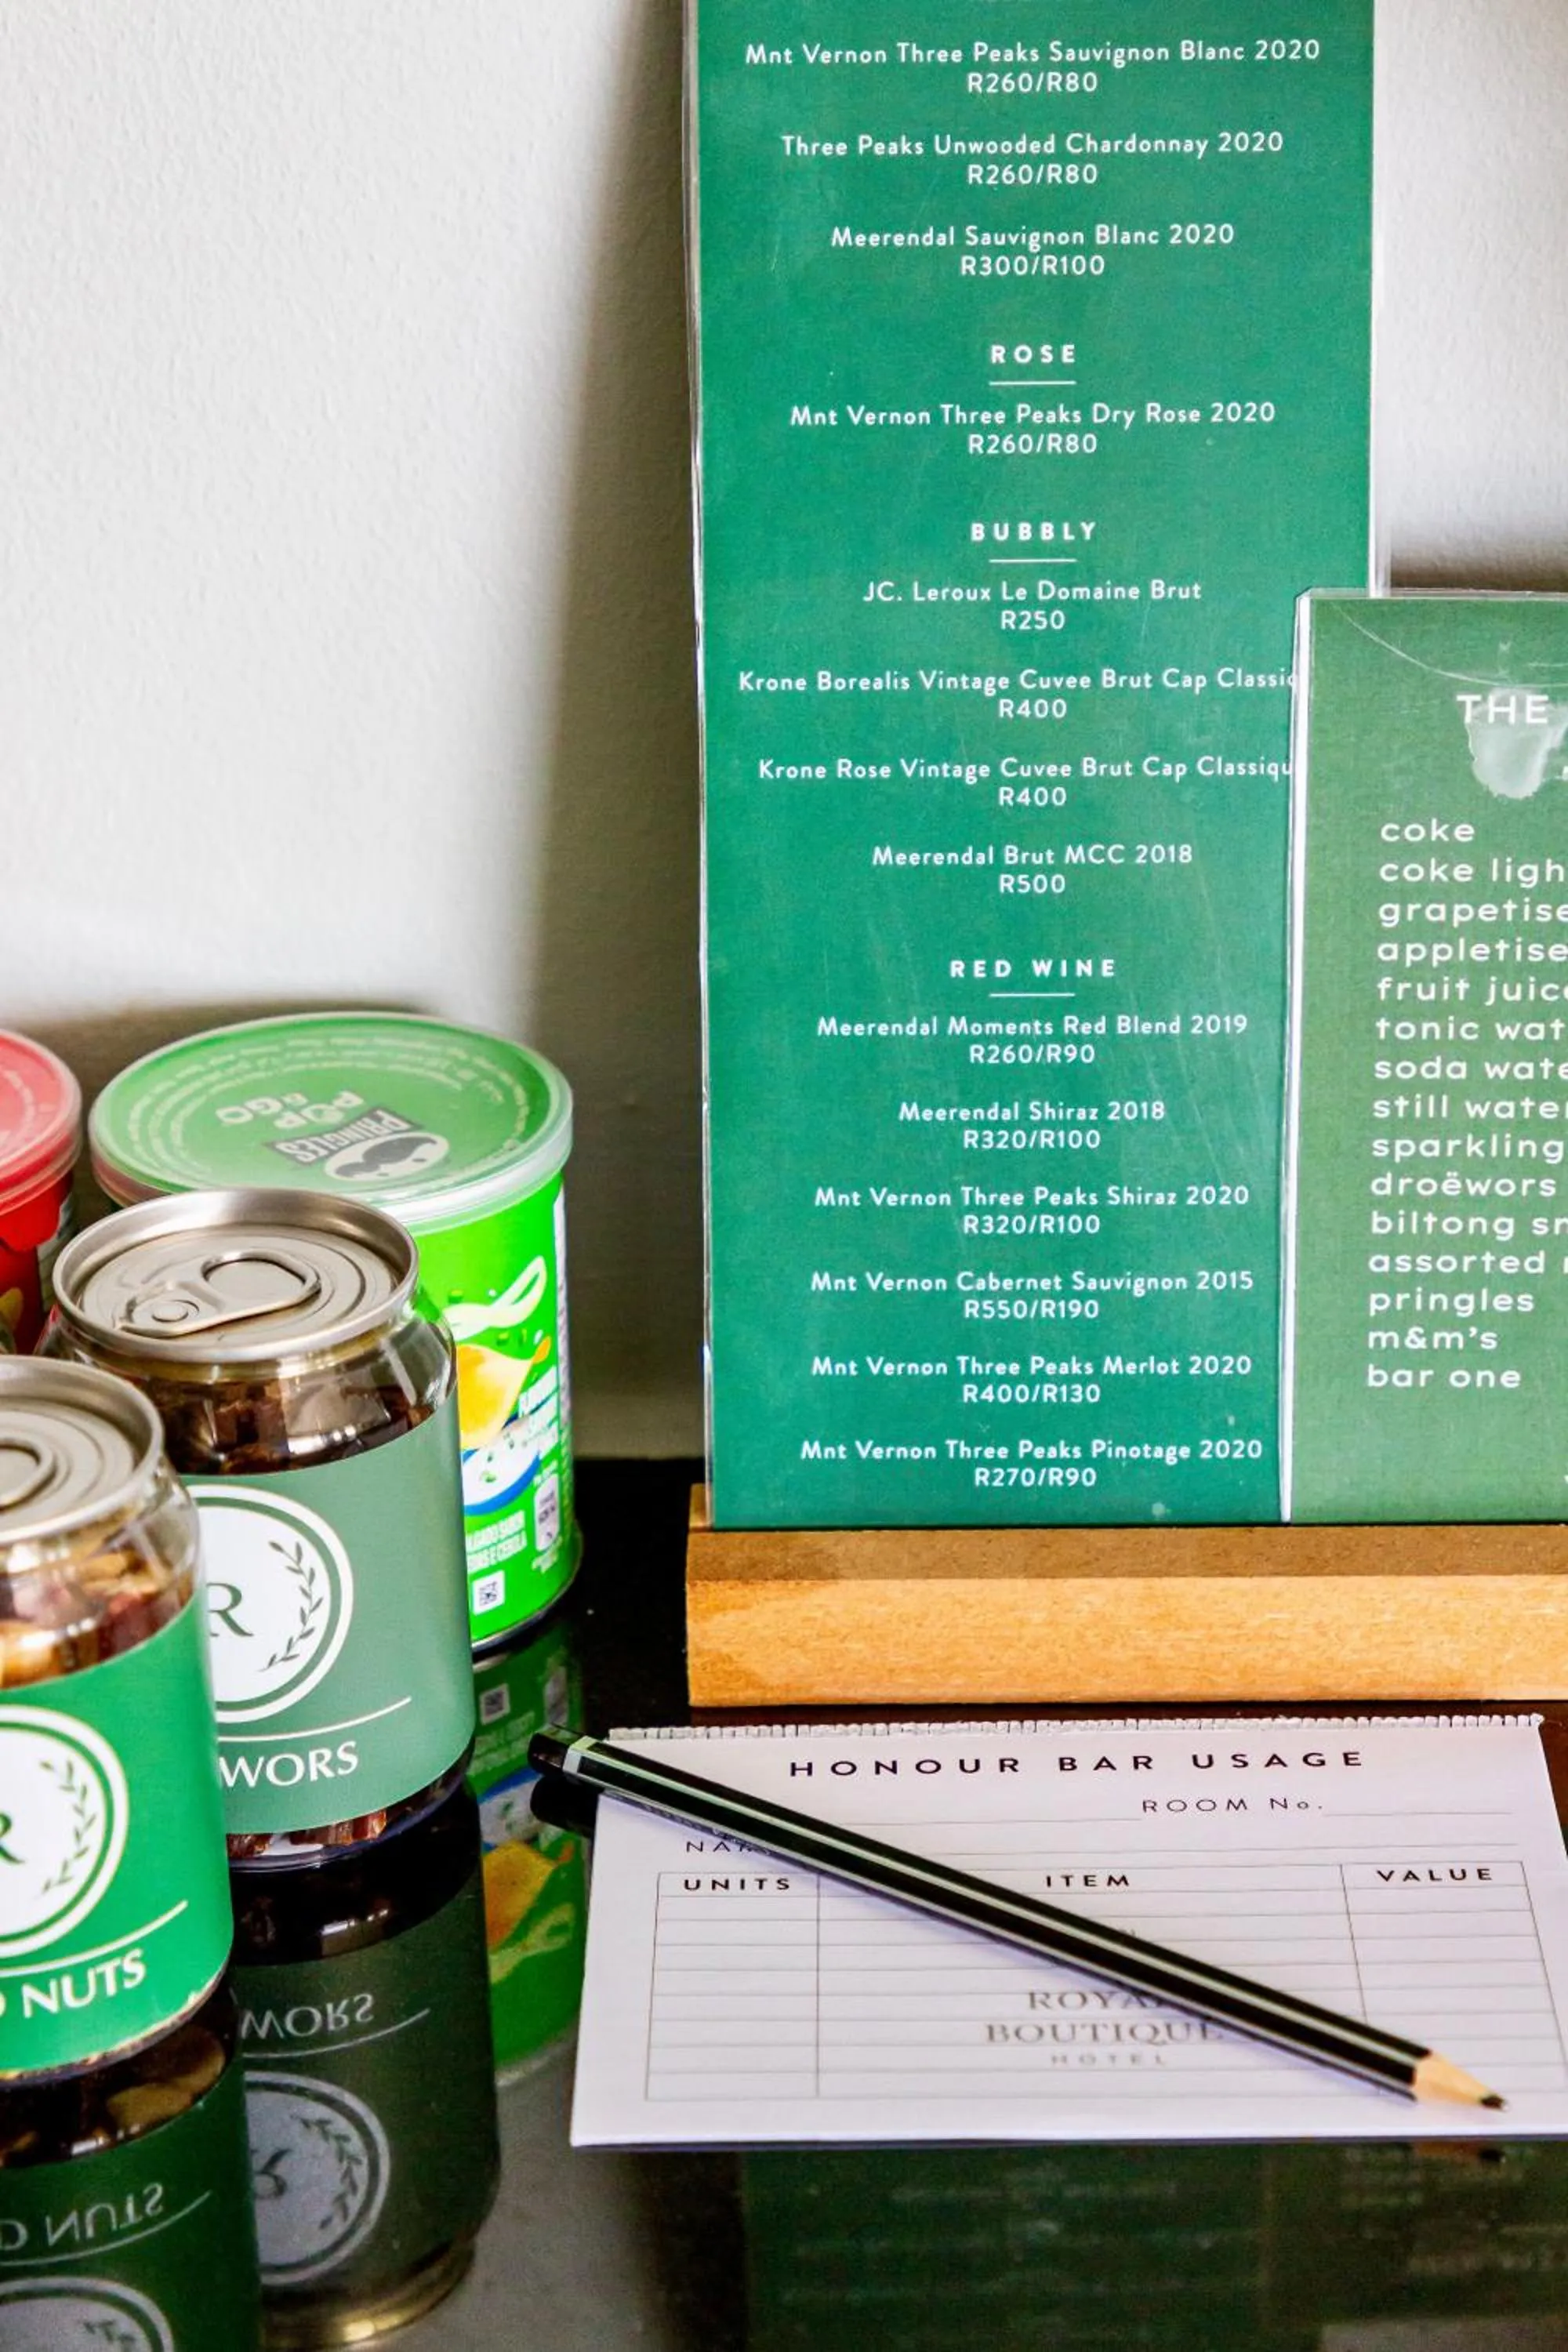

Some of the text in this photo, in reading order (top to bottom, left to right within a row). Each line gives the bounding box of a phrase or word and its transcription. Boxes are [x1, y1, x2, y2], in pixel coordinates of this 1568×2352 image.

[746, 38, 1319, 69] Mnt Vernon Three Peaks Sauvignon Blanc 2020
[967, 71, 1098, 94] R260/R80
[782, 131, 1283, 160] Three Peaks Unwooded Chardonnay 2020
[967, 163, 1098, 185] R260/R80
[831, 223, 1235, 254] Meerendal Sauvignon Blanc 2020
[960, 254, 1105, 277] R300/R100
[990, 344, 1075, 364] ROSE
[790, 401, 1276, 430] Mnt Vernon Three Peaks Dry Rose 2020
[968, 432, 1097, 454] R260/R80
[971, 521, 1095, 542] BUBBLY
[863, 579, 1202, 602] JC. Leroux Le Domaine Brut
[1000, 609, 1065, 630] R250
[739, 671, 807, 691] Krone
[817, 670, 910, 691] Borealis
[919, 670, 1010, 697] Vintage
[1019, 668, 1091, 690] Cuvee
[1101, 668, 1152, 689] Brut
[1162, 667, 1207, 695] Cap
[999, 698, 1067, 719] R400
[1456, 694, 1549, 724] THE
[759, 759, 826, 779] Krone
[837, 758, 891, 779] Rose
[900, 758, 990, 785] Vintage
[1000, 757, 1072, 778] Cuvee
[1080, 756, 1133, 777] Brut
[1142, 755, 1188, 783] Cap
[998, 786, 1067, 807] R400
[1381, 818, 1475, 843] coke
[873, 843, 1193, 866] Meerendal Brut MCC 2018
[1379, 857, 1474, 883] coke
[999, 873, 1065, 894] R500
[949, 958, 1115, 978] RED WINE
[1377, 976, 1568, 1006] fruit juic
[818, 1013, 1249, 1036] Meerendal Moments Red Blend 2019
[1375, 1015, 1479, 1040] tonic
[970, 1044, 1095, 1064] R260/R90
[1374, 1055, 1467, 1080] soda
[898, 1099, 1167, 1122] Meerendal Shiraz 2018
[1373, 1093, 1568, 1120] still wate
[274, 1108, 412, 1163] PRINGLES
[964, 1129, 1101, 1149] R320/R100
[1372, 1133, 1564, 1164] sparkling
[815, 1183, 1250, 1207] Mnt Vernon Three Peaks Shiraz 2020
[1370, 1171, 1556, 1197] droëwors
[963, 1214, 1101, 1234] R320/R100
[1371, 1209, 1515, 1242] biltong
[1368, 1250, 1545, 1274] assorted
[811, 1269, 1254, 1298] Mnt Vernon Cabernet Sauvignon 2015
[964, 1299, 1099, 1319] R550/R190
[1369, 1287, 1534, 1318] pringles
[811, 1354, 1252, 1376] Mnt Vernon Three Peaks Merlot 2020
[1367, 1363, 1521, 1388] bar one
[963, 1383, 1101, 1403] R400/R130
[800, 1439, 1262, 1466] Mnt Vernon Three Peaks Pinotage 2020
[975, 1467, 1097, 1487] R270/R90
[789, 1750, 1364, 1778] HONOUR BAR USAGE
[1142, 1797, 1323, 1814] ROOM No.
[683, 1877, 790, 1892] UNITS
[1045, 1873, 1131, 1888] ITEM
[1376, 1867, 1494, 1882] VALUE
[20, 1947, 147, 2019] NUTS
[1027, 1991, 1167, 2010] ROYA
[1051, 2053, 1168, 2066] HOTEL
